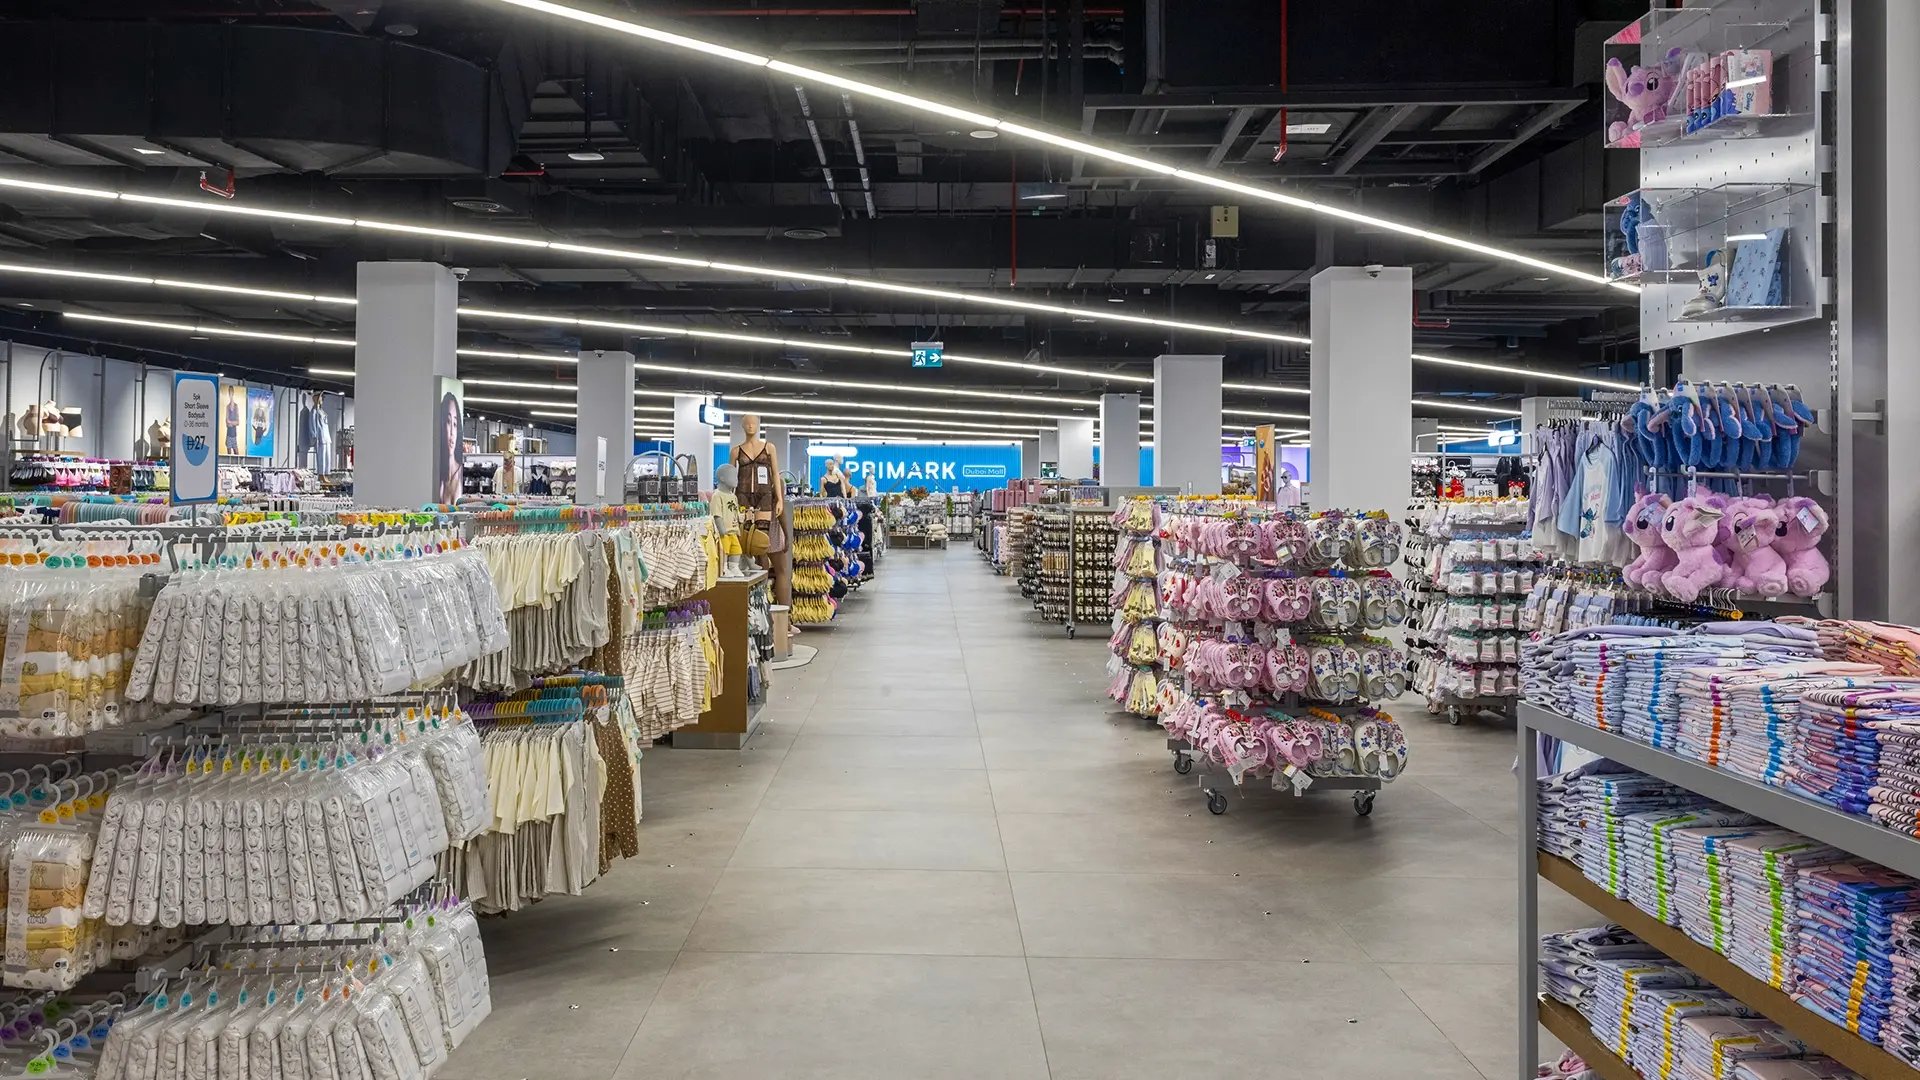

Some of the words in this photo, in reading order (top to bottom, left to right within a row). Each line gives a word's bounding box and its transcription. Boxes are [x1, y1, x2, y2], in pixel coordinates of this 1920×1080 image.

[1744, 91, 1755, 111] Disney
[196, 402, 209, 410] Sleeve
[188, 411, 205, 420] Bodysuit
[845, 461, 956, 480] PRIMARK
